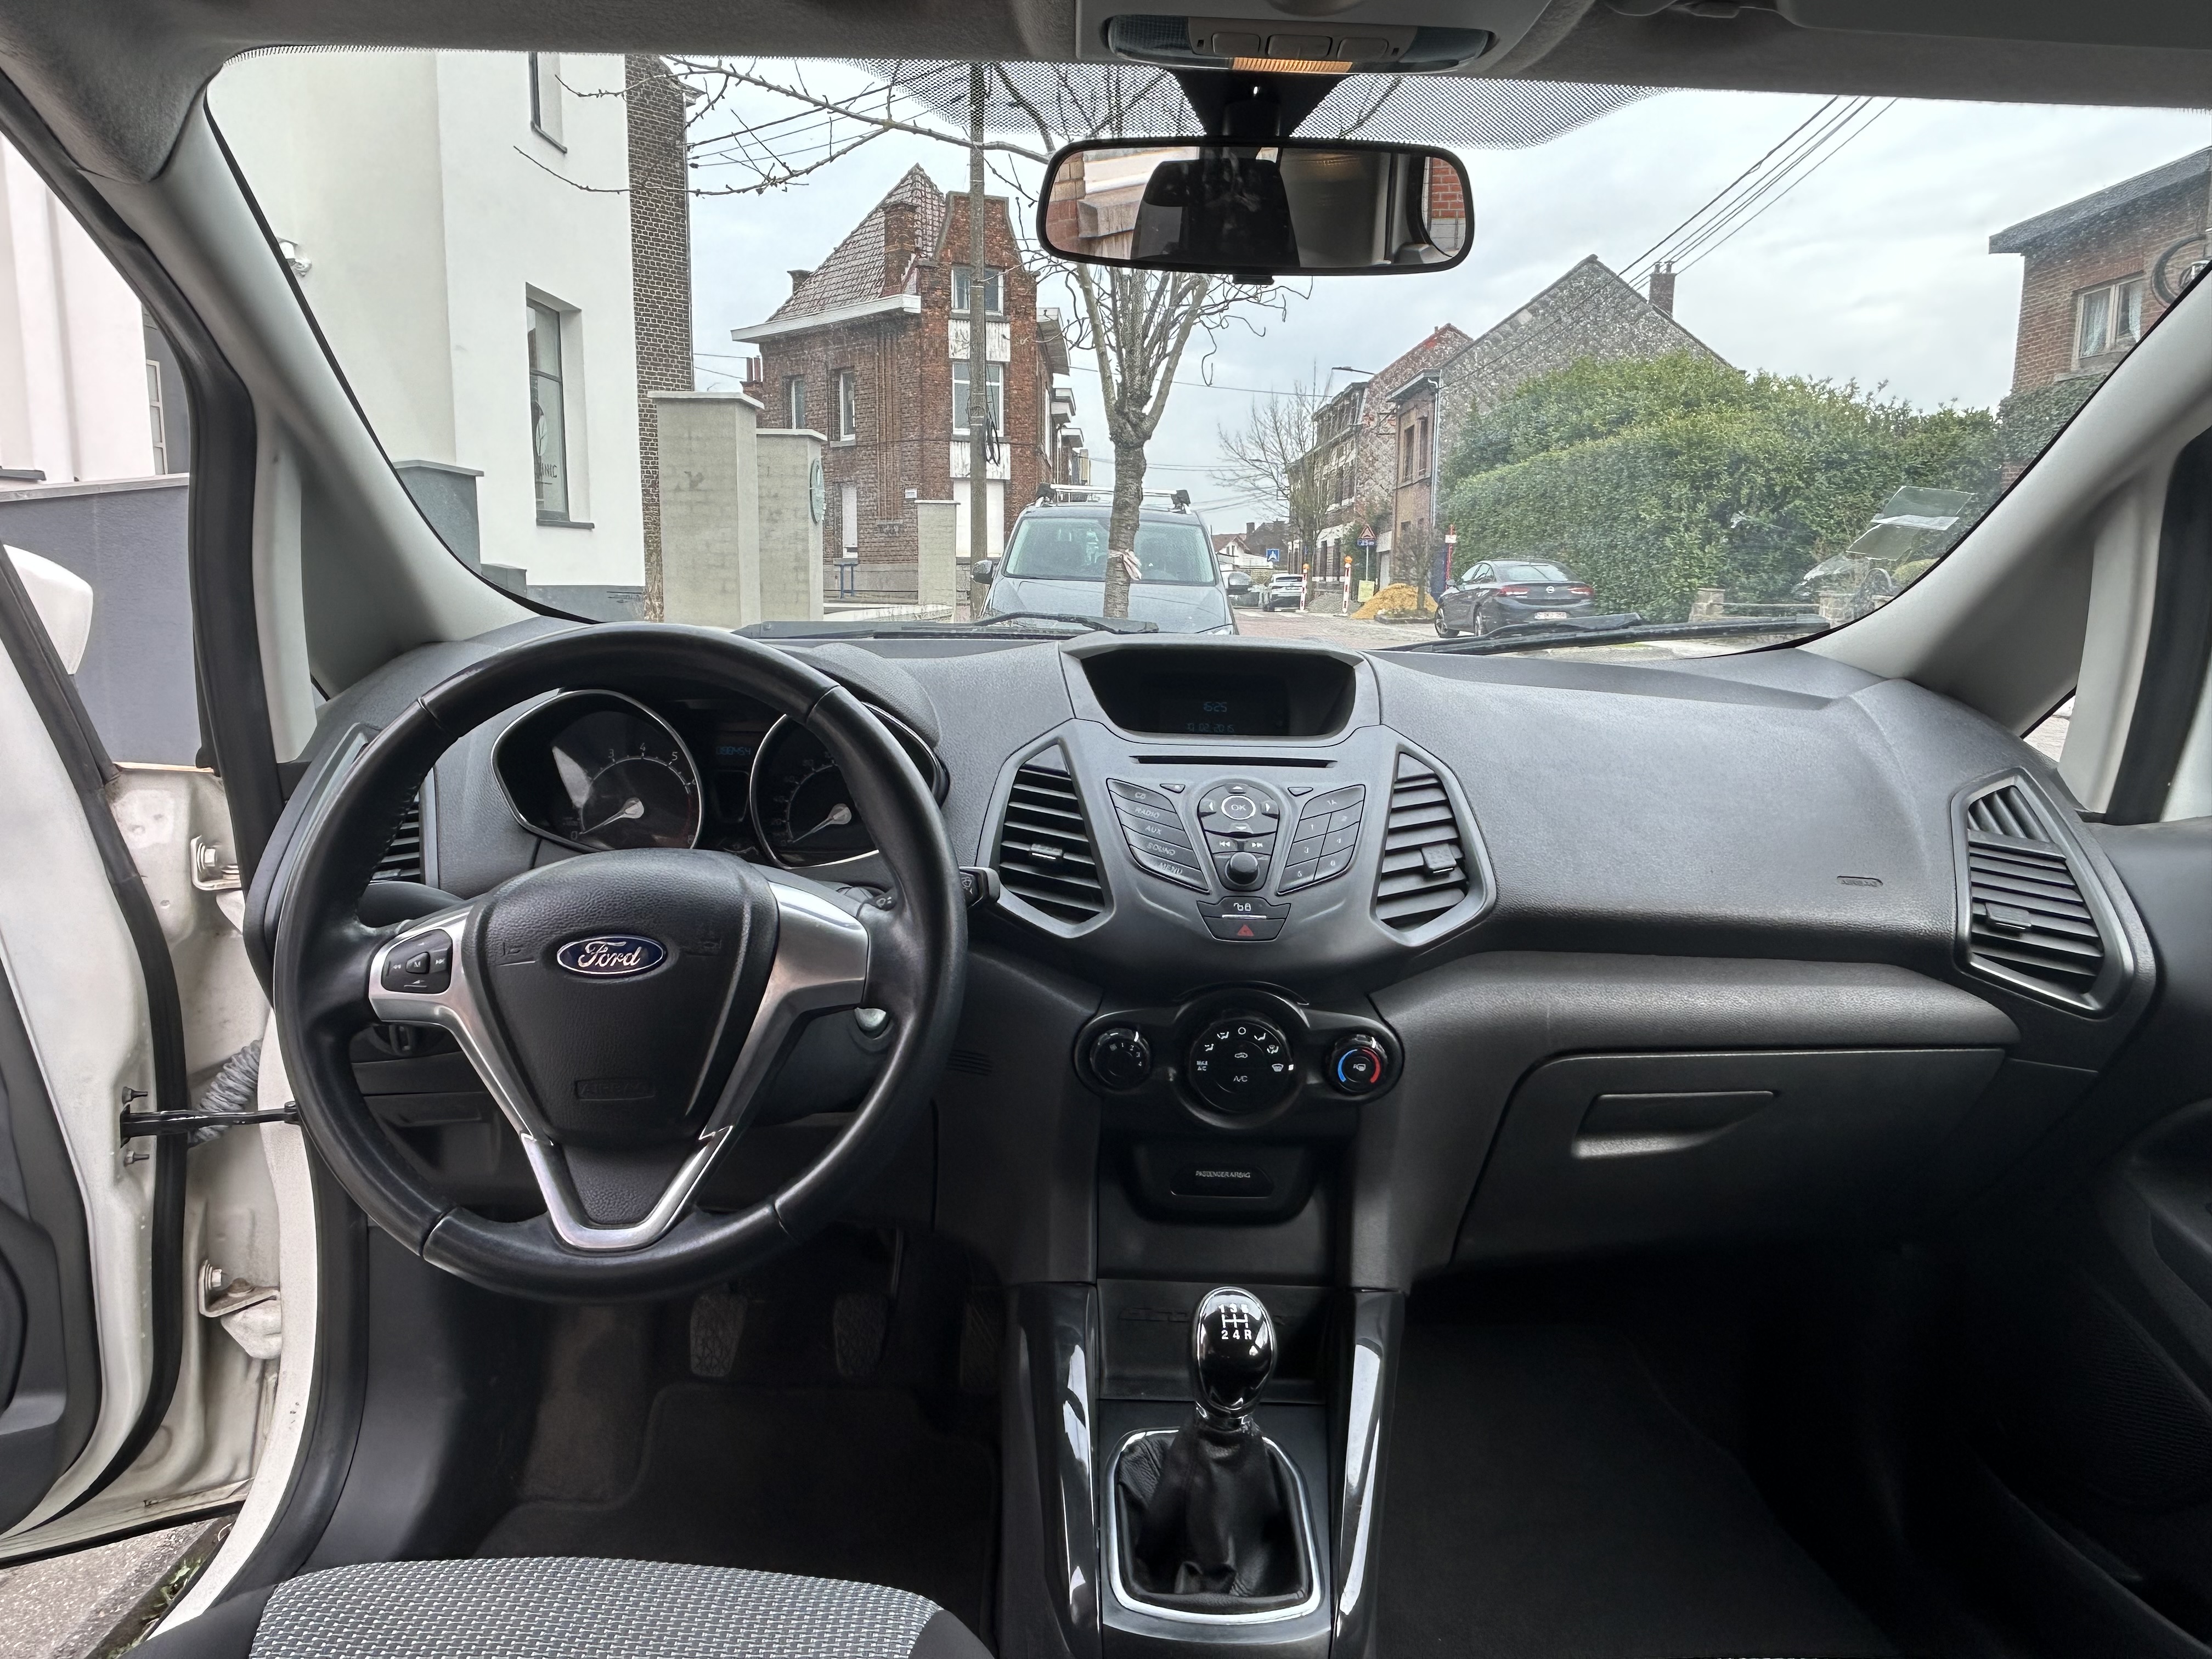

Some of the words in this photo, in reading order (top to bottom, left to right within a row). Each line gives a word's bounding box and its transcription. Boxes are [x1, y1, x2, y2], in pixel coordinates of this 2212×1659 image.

[608, 748, 614, 758] 3
[672, 751, 678, 761] 5
[1135, 806, 1160, 819] RADIO
[1145, 825, 1163, 835] AUX
[1147, 842, 1176, 856] SOUND
[1159, 862, 1183, 874] MENU
[577, 940, 643, 968] Ford
[1218, 1304, 1225, 1313] 1
[1229, 1303, 1238, 1313] 3
[1221, 1329, 1229, 1340] 2
[1232, 1329, 1240, 1340] 4
[1244, 1329, 1252, 1340] R
